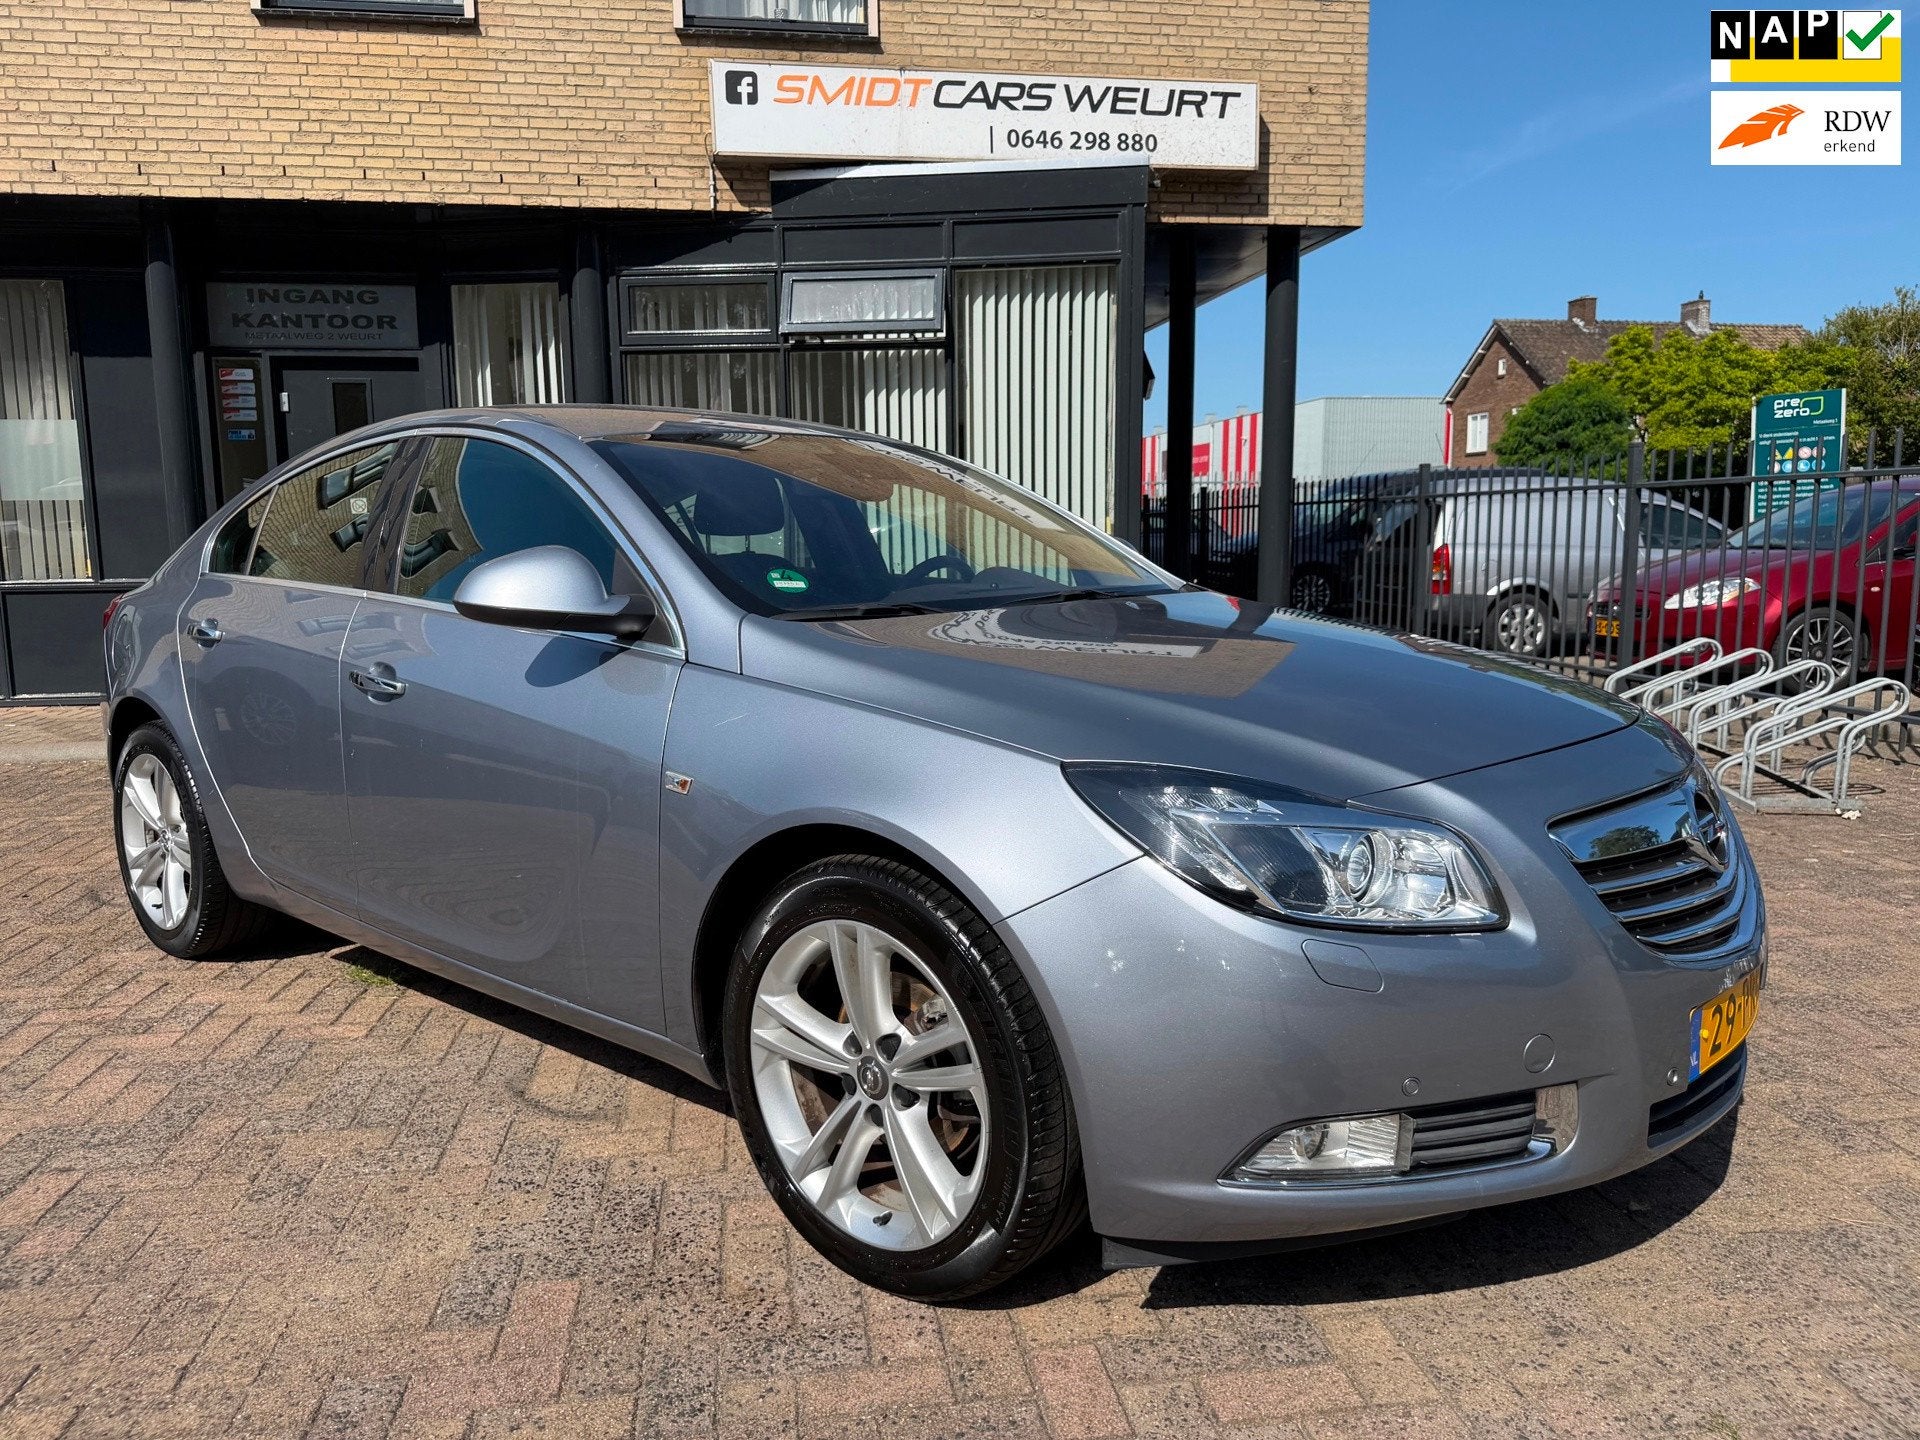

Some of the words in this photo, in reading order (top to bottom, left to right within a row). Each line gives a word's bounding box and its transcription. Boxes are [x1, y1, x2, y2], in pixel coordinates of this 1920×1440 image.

[773, 75, 932, 107] SMIDT
[933, 80, 1056, 112] CARS
[1064, 84, 1241, 119] WEURT
[1007, 129, 1063, 149] 0646
[1069, 131, 1111, 151] 298
[1117, 133, 1158, 152] 880
[246, 288, 380, 305] INGANG
[232, 313, 398, 330] KANTOOR
[337, 332, 384, 341] WEURT
[1773, 398, 1800, 411] pre
[1773, 407, 1810, 419] zero
